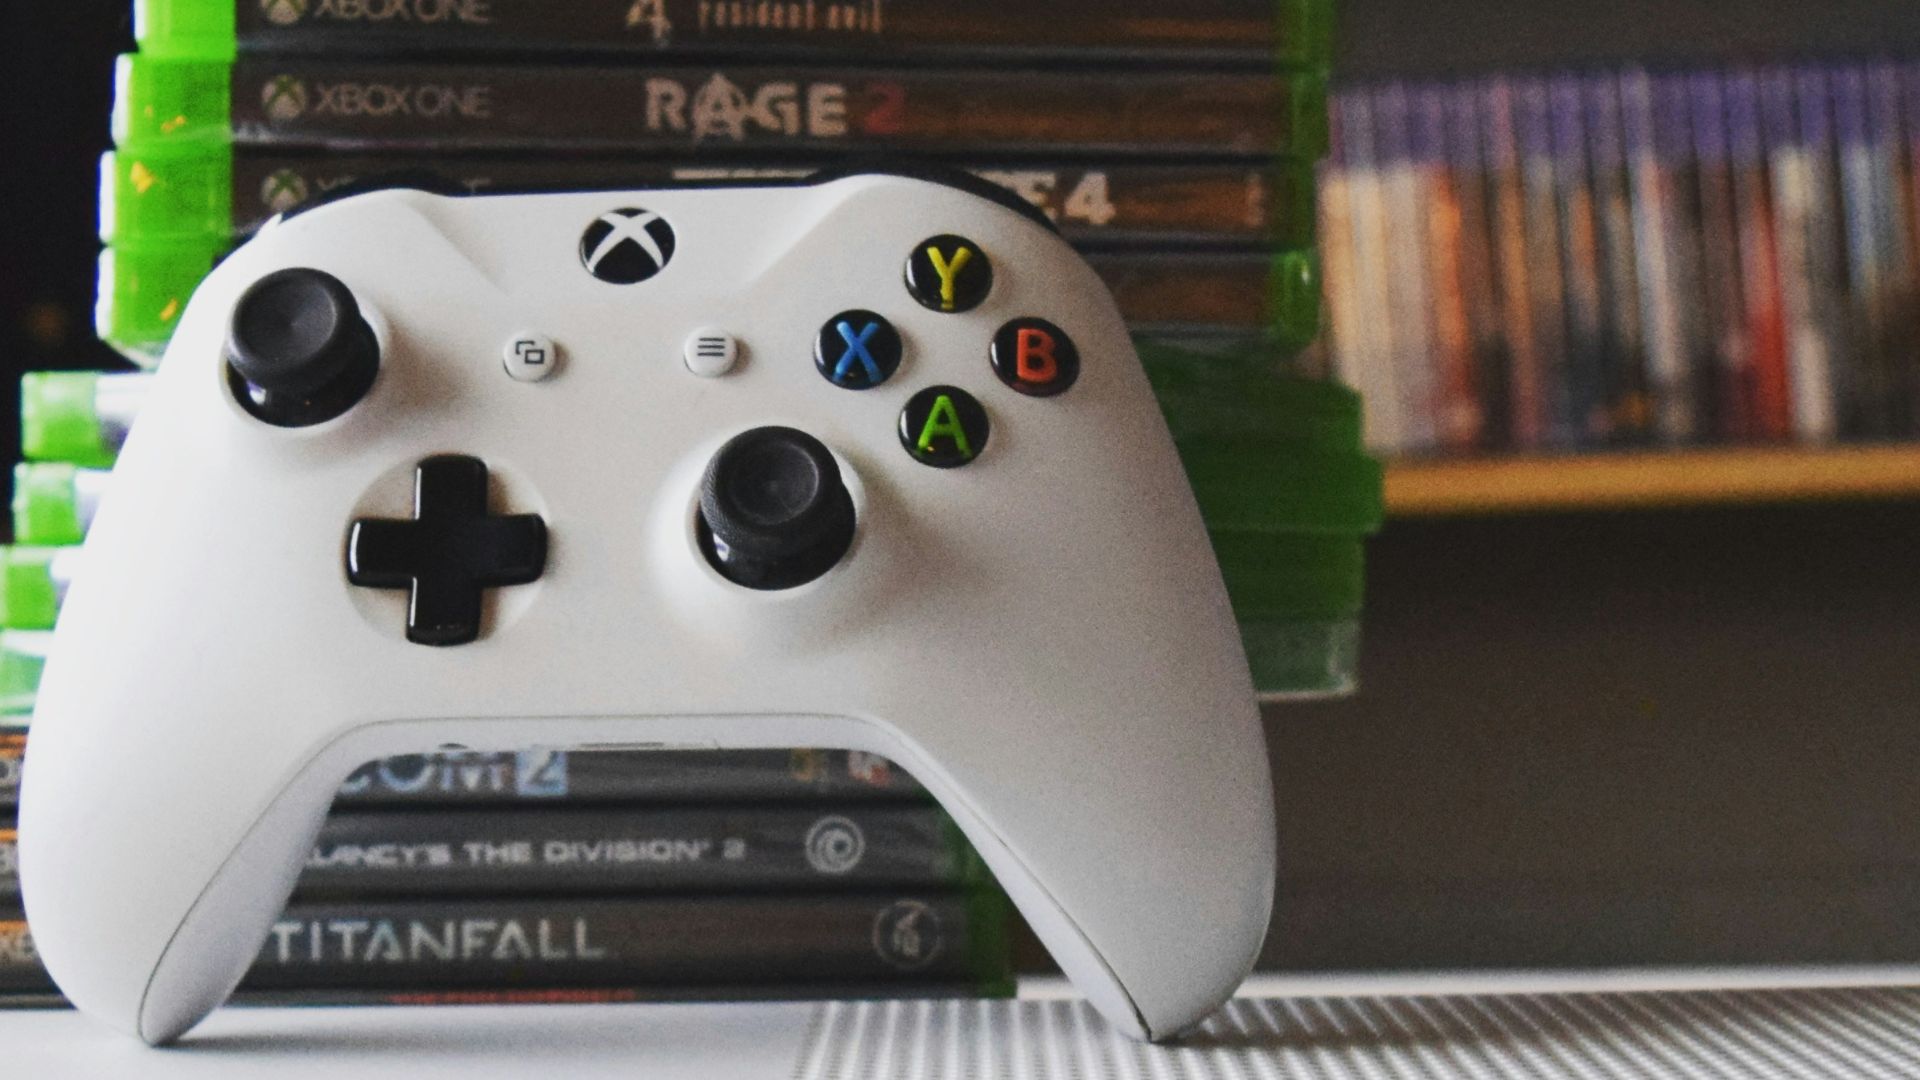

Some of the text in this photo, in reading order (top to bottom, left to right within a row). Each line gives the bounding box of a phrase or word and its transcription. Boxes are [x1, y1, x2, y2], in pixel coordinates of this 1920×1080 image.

[315, 84, 491, 118] XBOX ONE
[644, 74, 905, 141] RAGE 2
[1065, 171, 1116, 224] 4
[926, 246, 973, 310] Y
[833, 321, 880, 382] X
[1017, 327, 1057, 383] B
[917, 395, 972, 457] A
[462, 843, 532, 865] THE
[272, 919, 607, 962] TITANFALL
